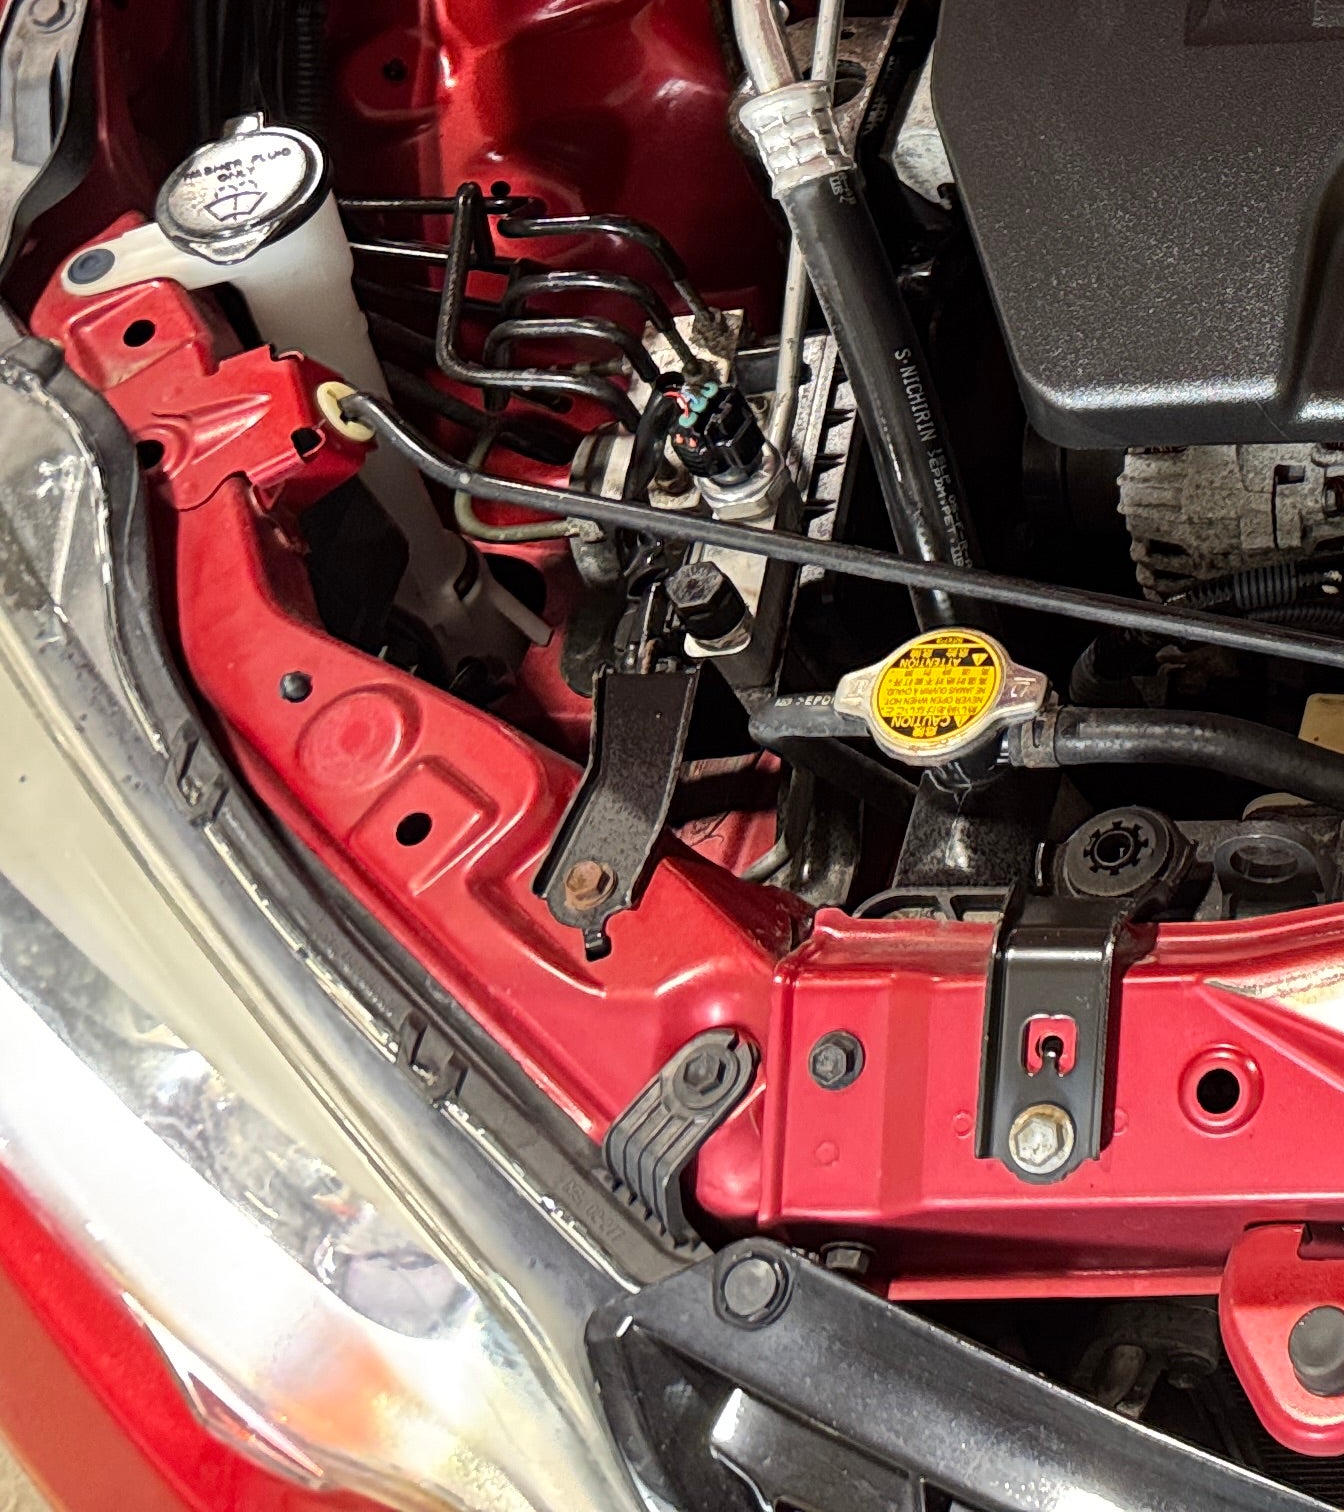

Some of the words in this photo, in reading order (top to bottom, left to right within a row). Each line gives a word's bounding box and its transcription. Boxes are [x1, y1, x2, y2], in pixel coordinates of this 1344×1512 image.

[899, 657, 963, 668] ATTENTION
[948, 687, 975, 695] JAMAIS
[883, 697, 903, 705] HOT
[904, 696, 929, 704] WHEN
[930, 696, 954, 704] OPEN
[956, 696, 984, 705] NEVER
[890, 715, 951, 728] CAUTION
